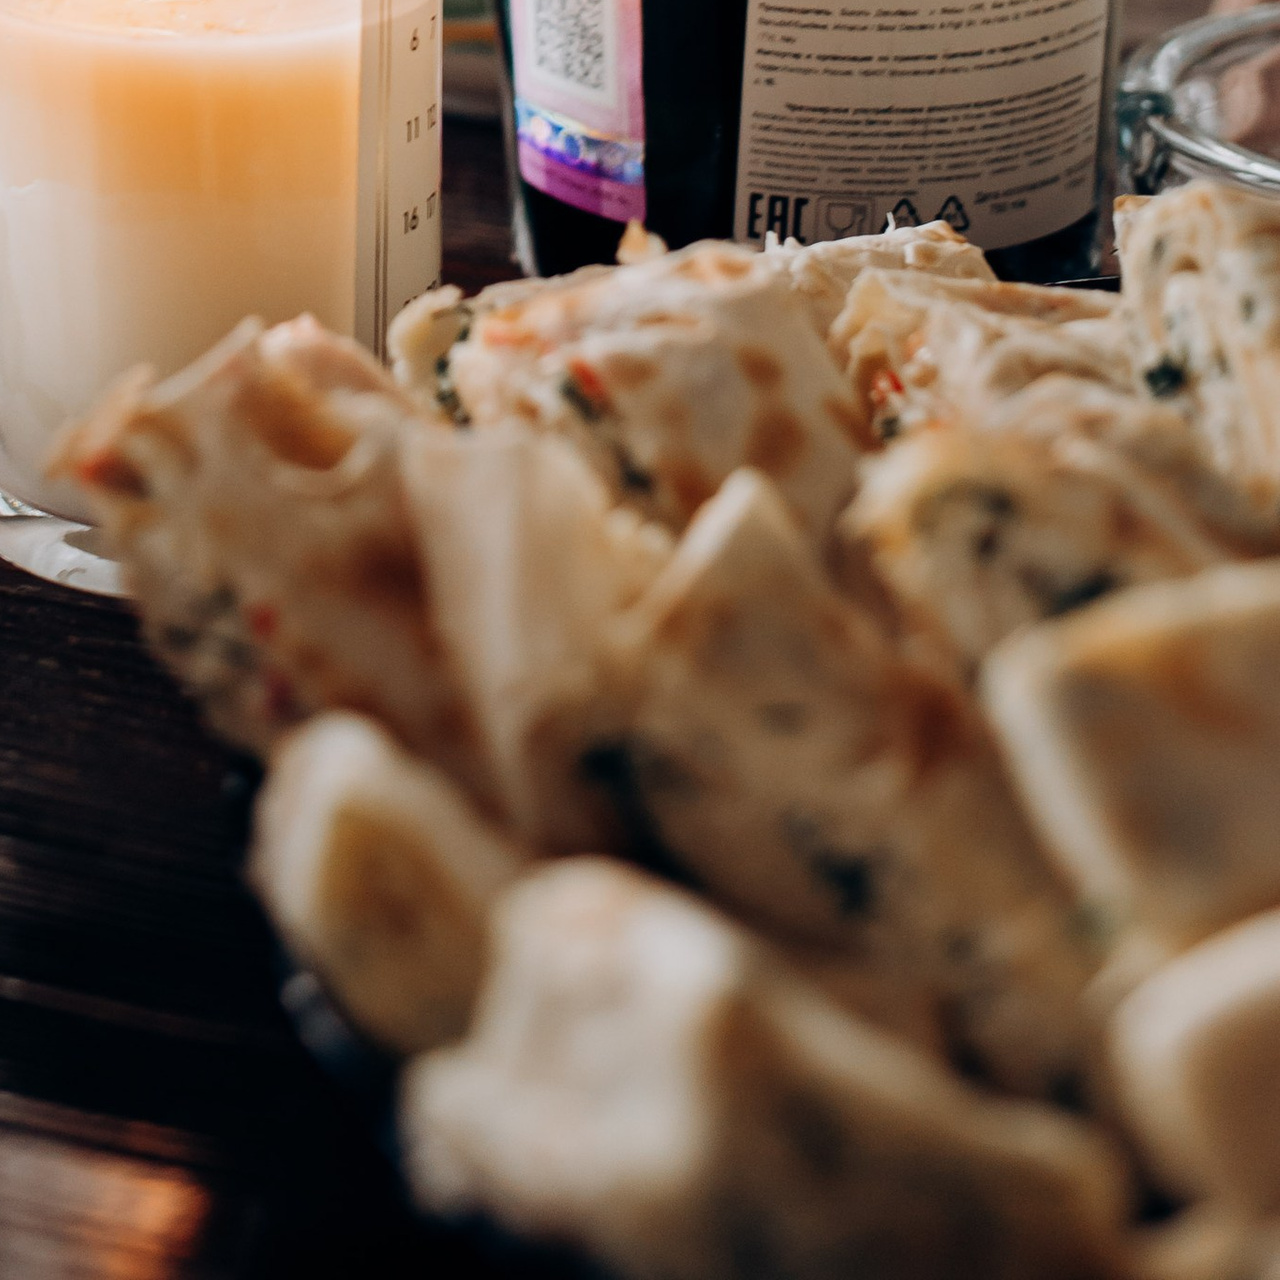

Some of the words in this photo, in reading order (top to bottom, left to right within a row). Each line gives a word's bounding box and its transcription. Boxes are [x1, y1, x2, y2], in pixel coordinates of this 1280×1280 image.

[410, 27, 419, 51] 6
[406, 116, 419, 142] 11
[403, 206, 419, 235] 16
[748, 192, 809, 246] EAC
